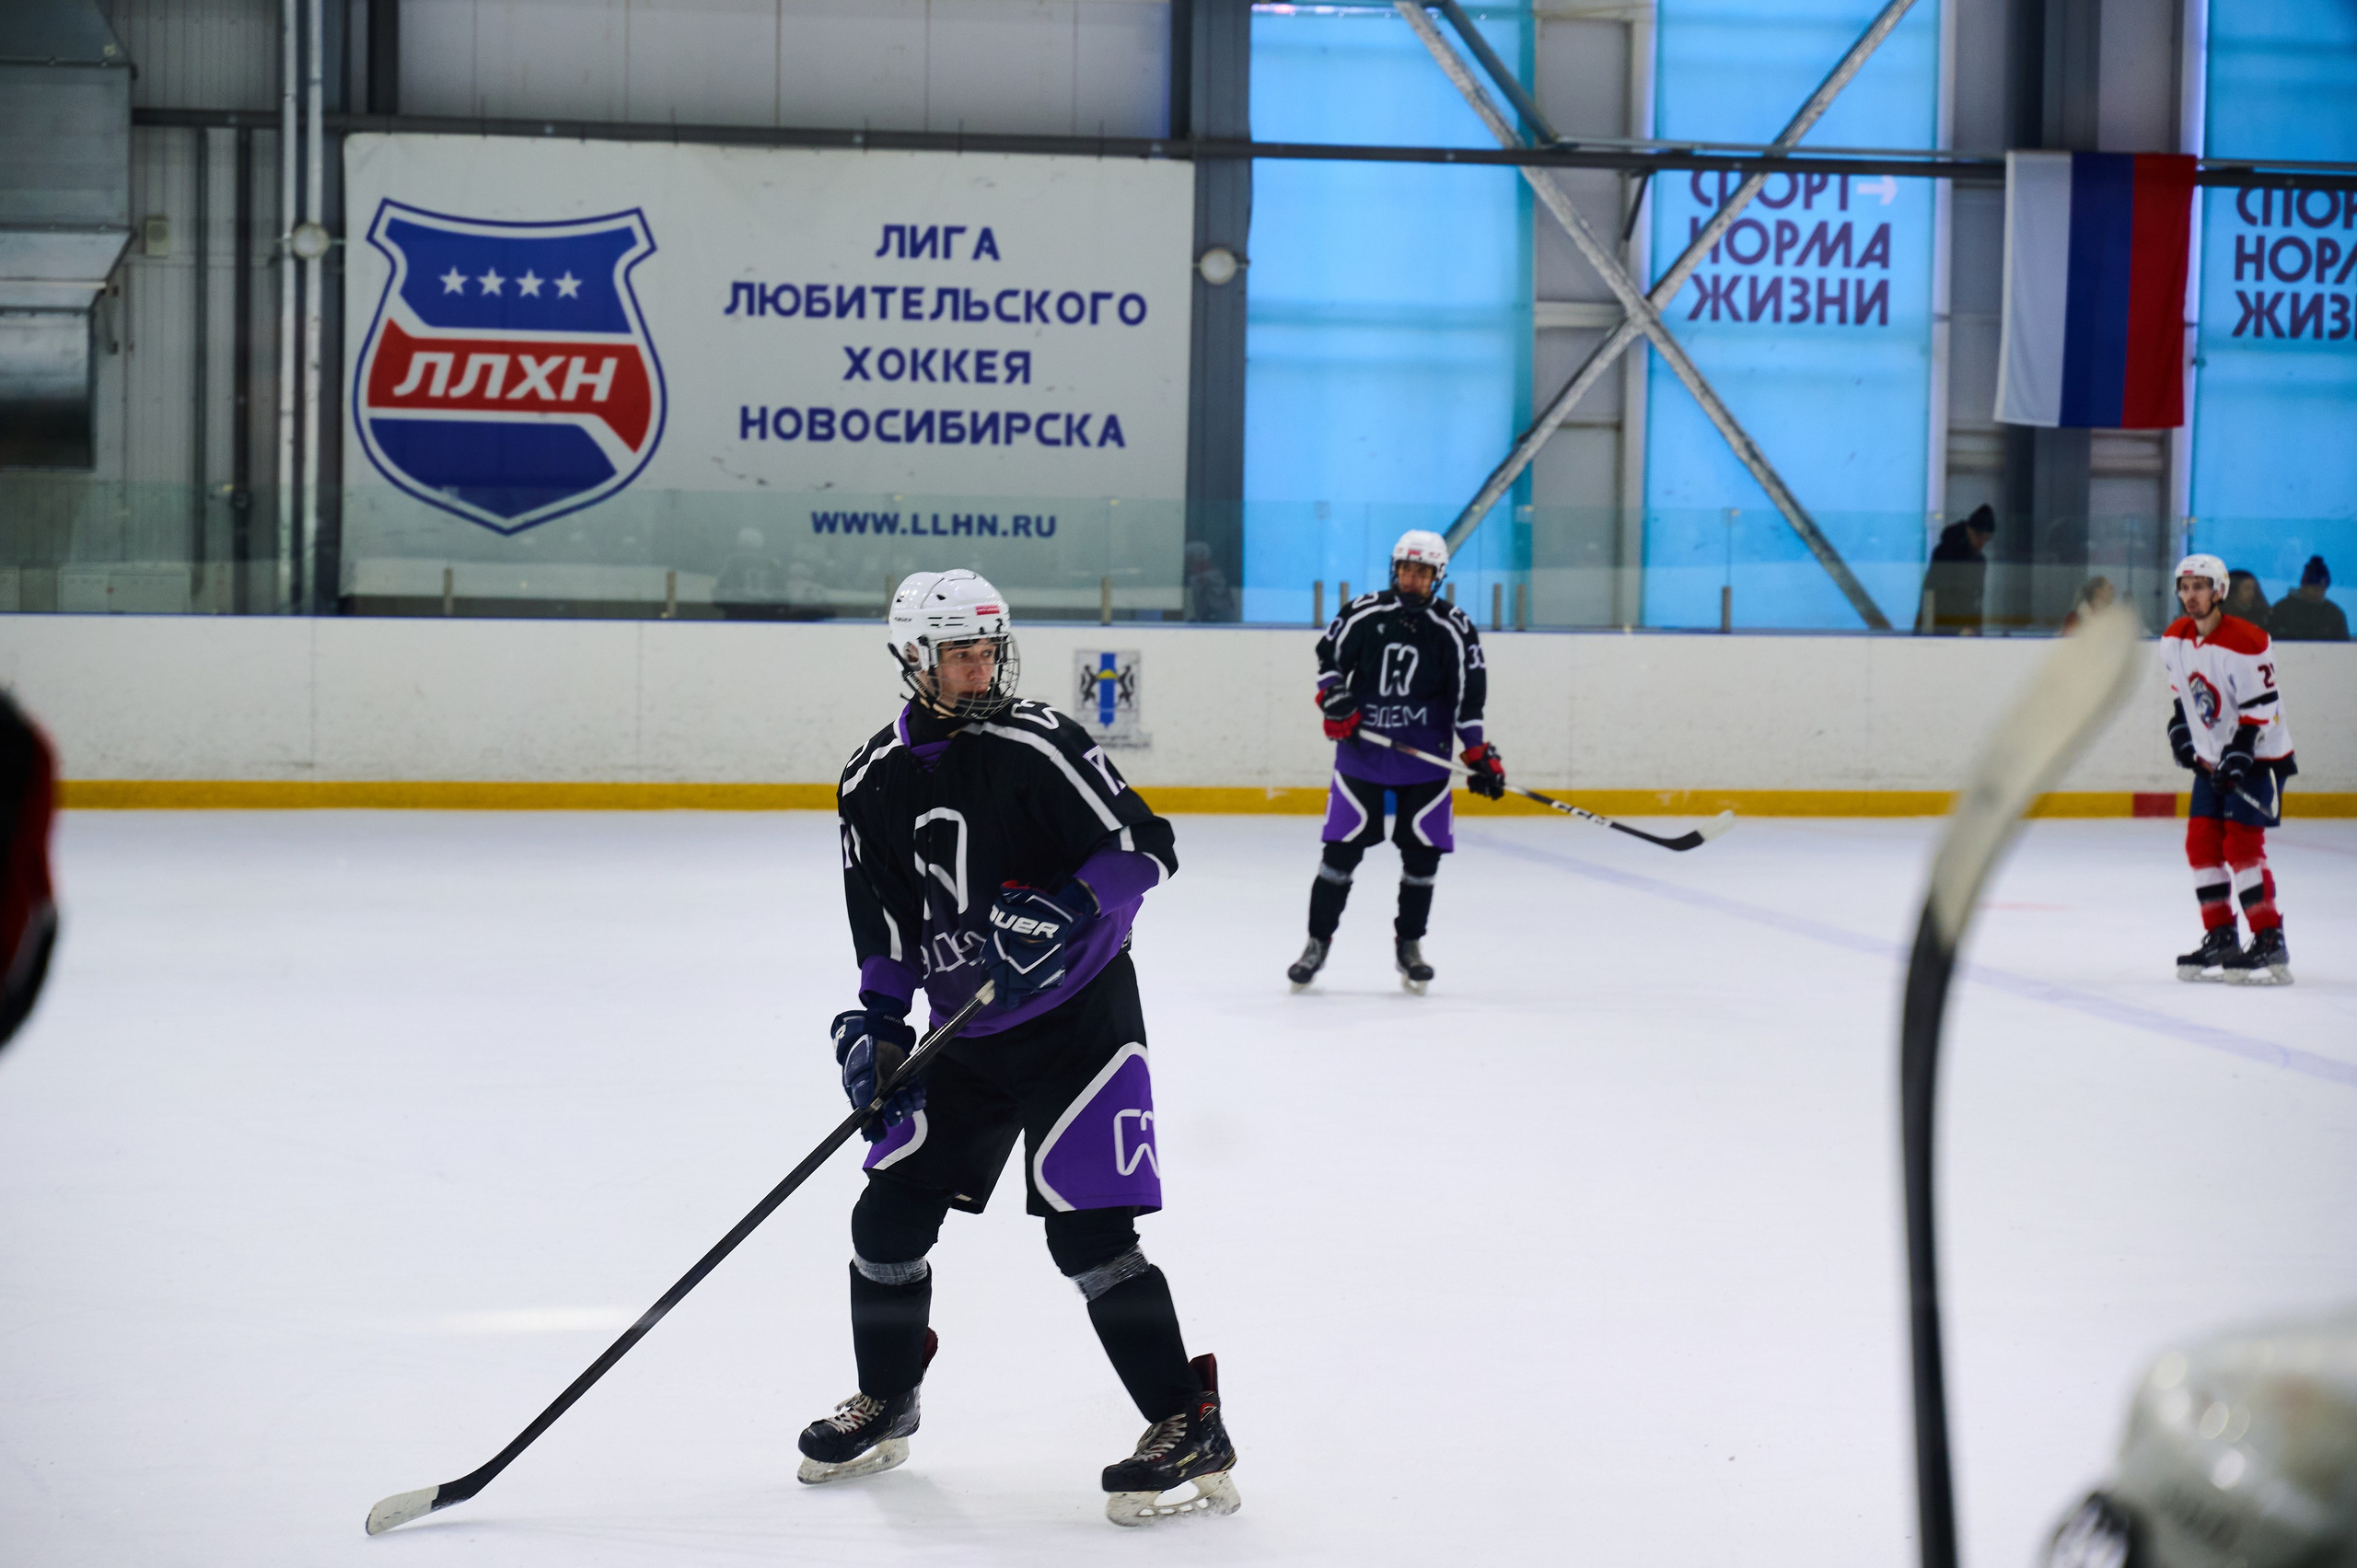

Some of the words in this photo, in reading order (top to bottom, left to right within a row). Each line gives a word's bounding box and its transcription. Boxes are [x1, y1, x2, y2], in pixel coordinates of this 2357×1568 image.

[876, 224, 1001, 261] ЛИГА
[724, 281, 1148, 327] ЛЮБИТЕЛЬСКОГО
[1687, 273, 1890, 327] ЖИЗНИ
[2231, 290, 2357, 342] ЖИЗ
[393, 352, 618, 401] ЛЛХН
[842, 345, 1032, 385] ХОККЕЯ
[739, 405, 1126, 448] НОВОСИБИРСКА
[810, 510, 1058, 539] WWW.LLHN.RU
